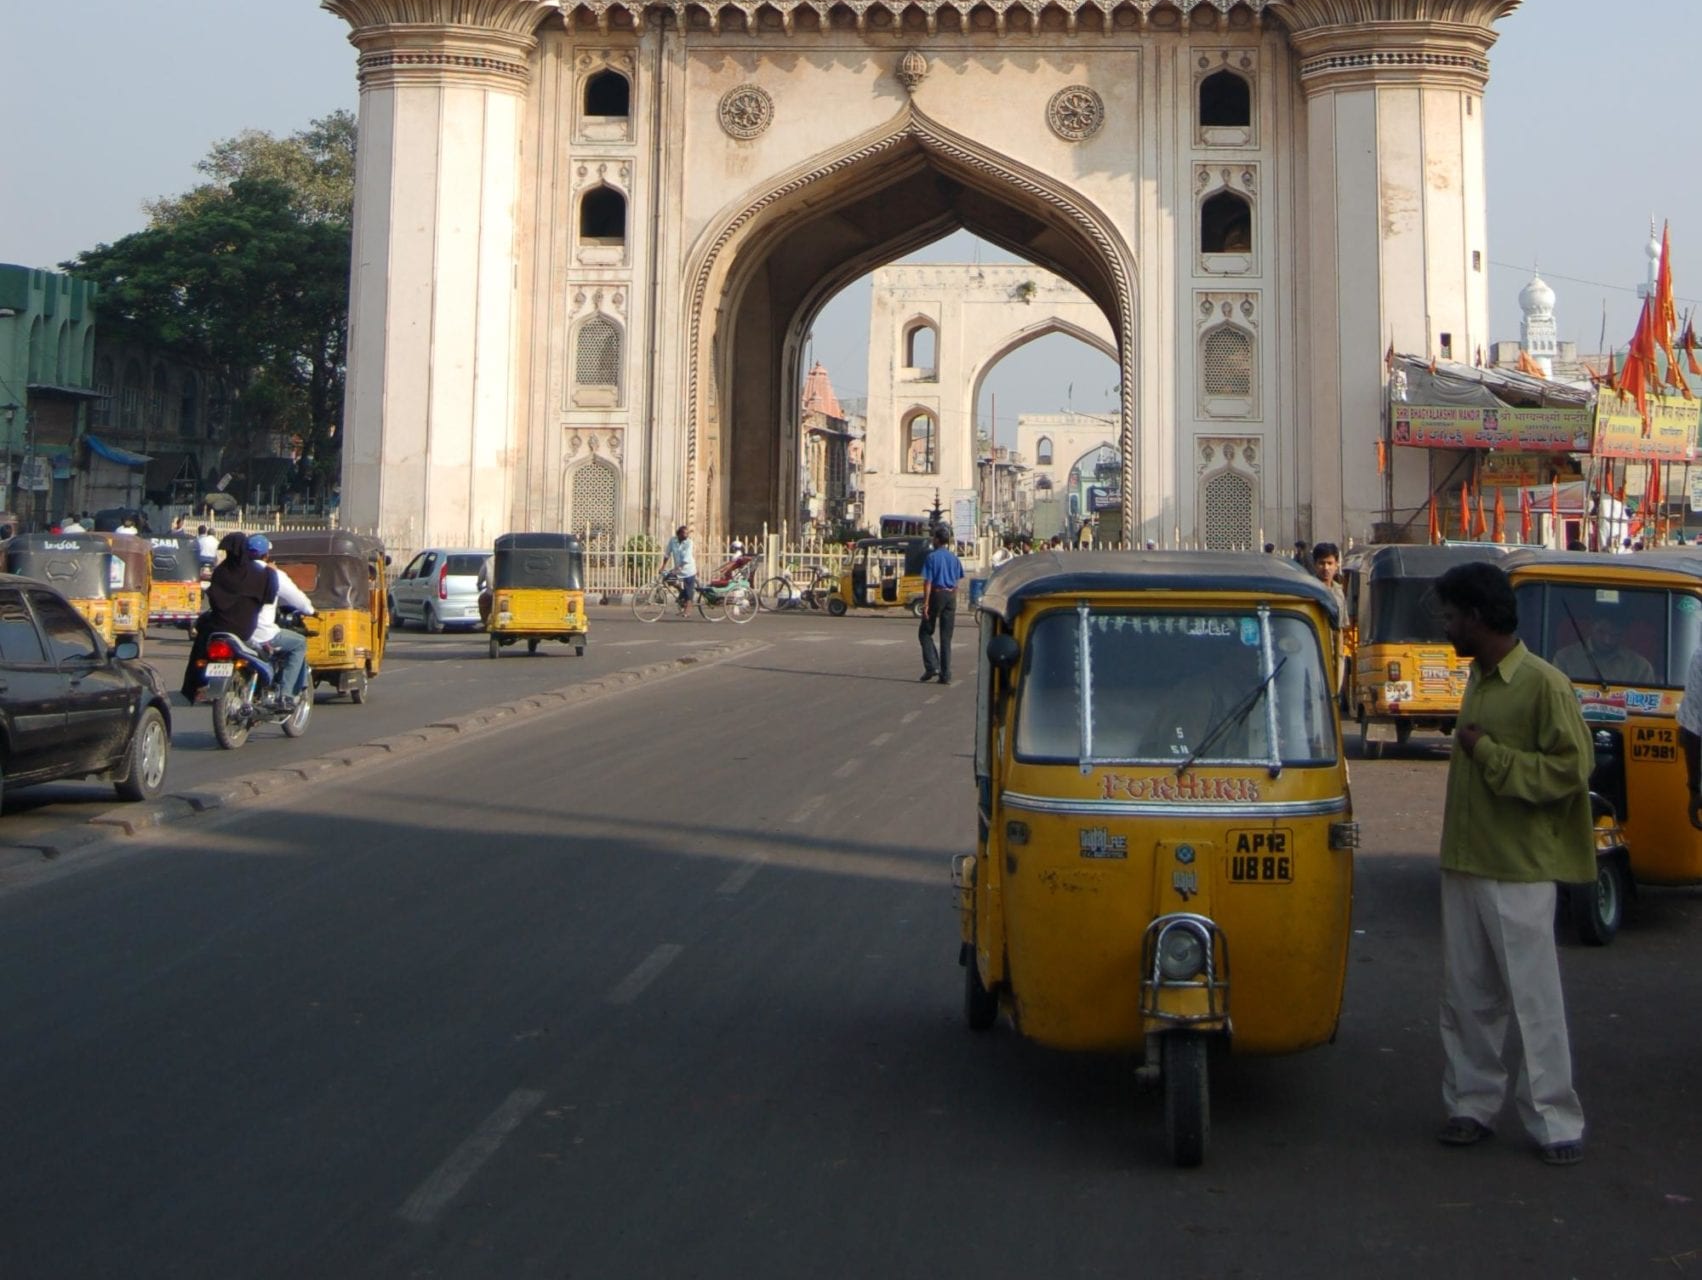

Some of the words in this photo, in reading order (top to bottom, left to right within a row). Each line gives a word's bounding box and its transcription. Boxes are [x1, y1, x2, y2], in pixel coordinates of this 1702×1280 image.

[1459, 408, 1481, 421] MANDIR
[151, 537, 179, 550] SABA
[1637, 728, 1654, 741] AP
[1658, 729, 1673, 743] 12
